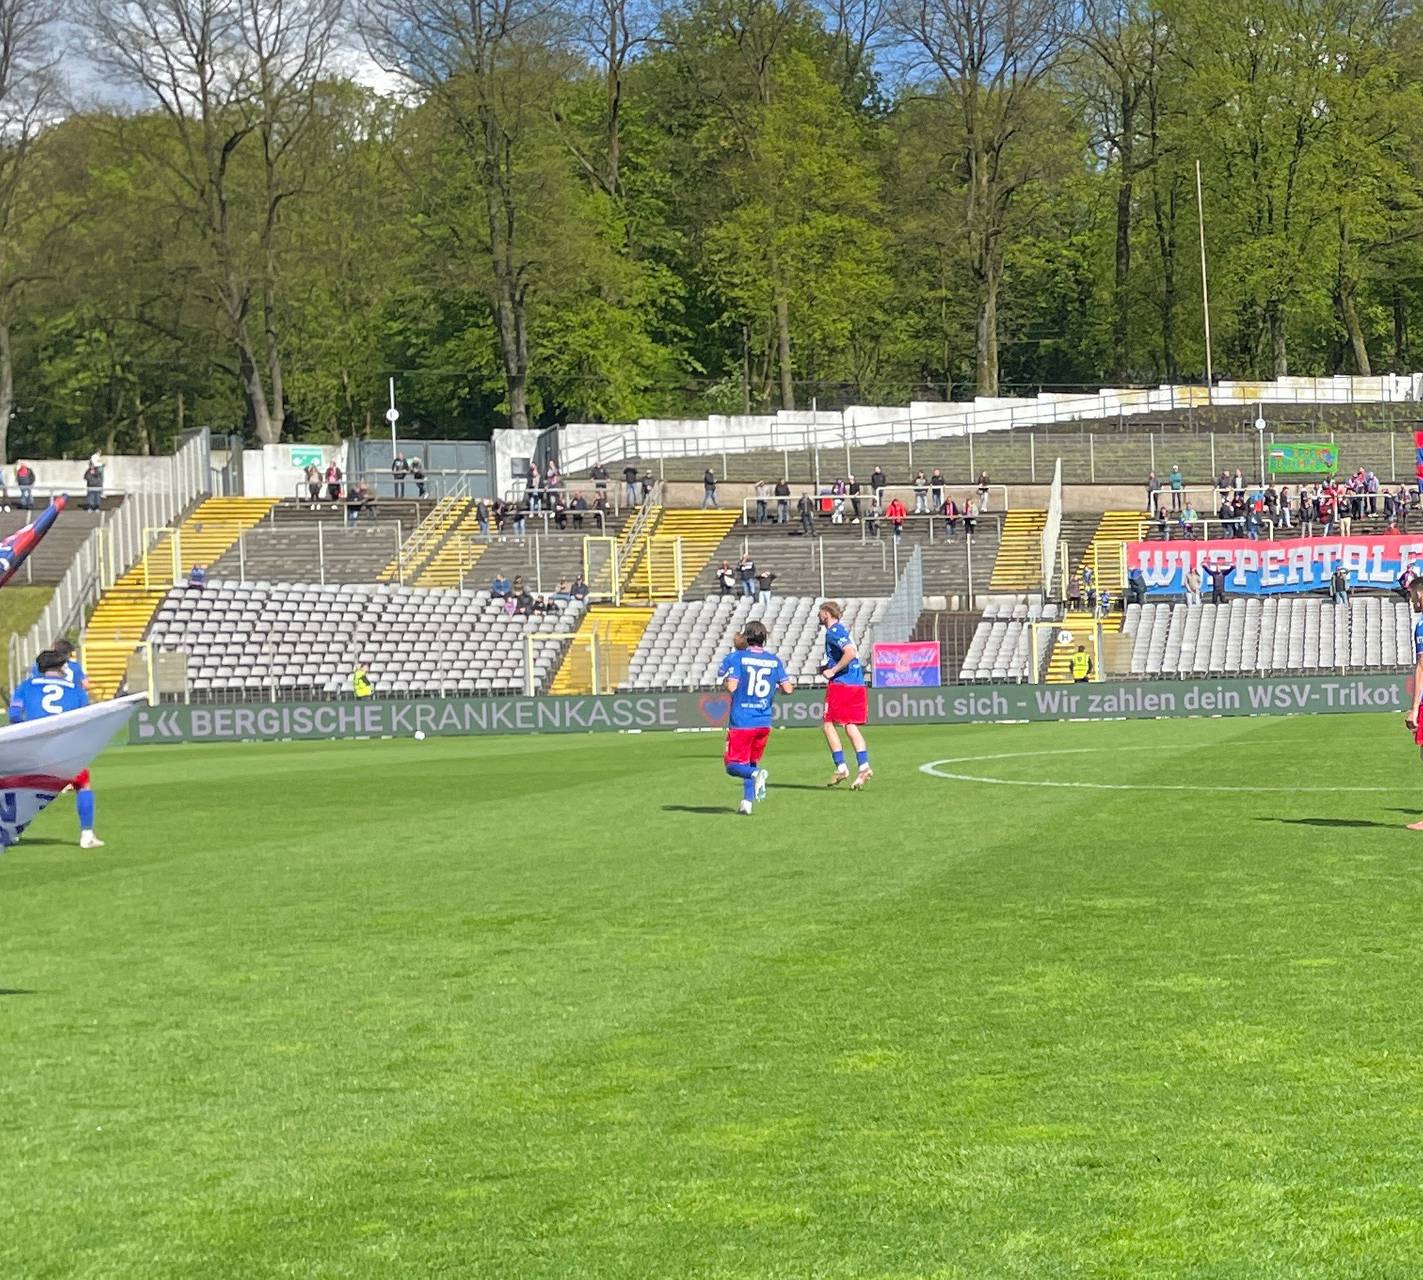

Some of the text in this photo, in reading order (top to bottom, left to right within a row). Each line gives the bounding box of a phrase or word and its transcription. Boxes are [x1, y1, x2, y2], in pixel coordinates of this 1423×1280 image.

[747, 665, 771, 698] 16
[42, 684, 64, 714] 2
[878, 694, 945, 718] lohnt
[953, 692, 1008, 716] sich
[1035, 690, 1081, 714] Wir
[1088, 687, 1176, 712] zahlen
[1184, 686, 1240, 710] dein
[1248, 683, 1400, 708] WSV-Trikot
[191, 705, 383, 736] BERGISCHE
[391, 699, 679, 731] KRANKENKASSE
